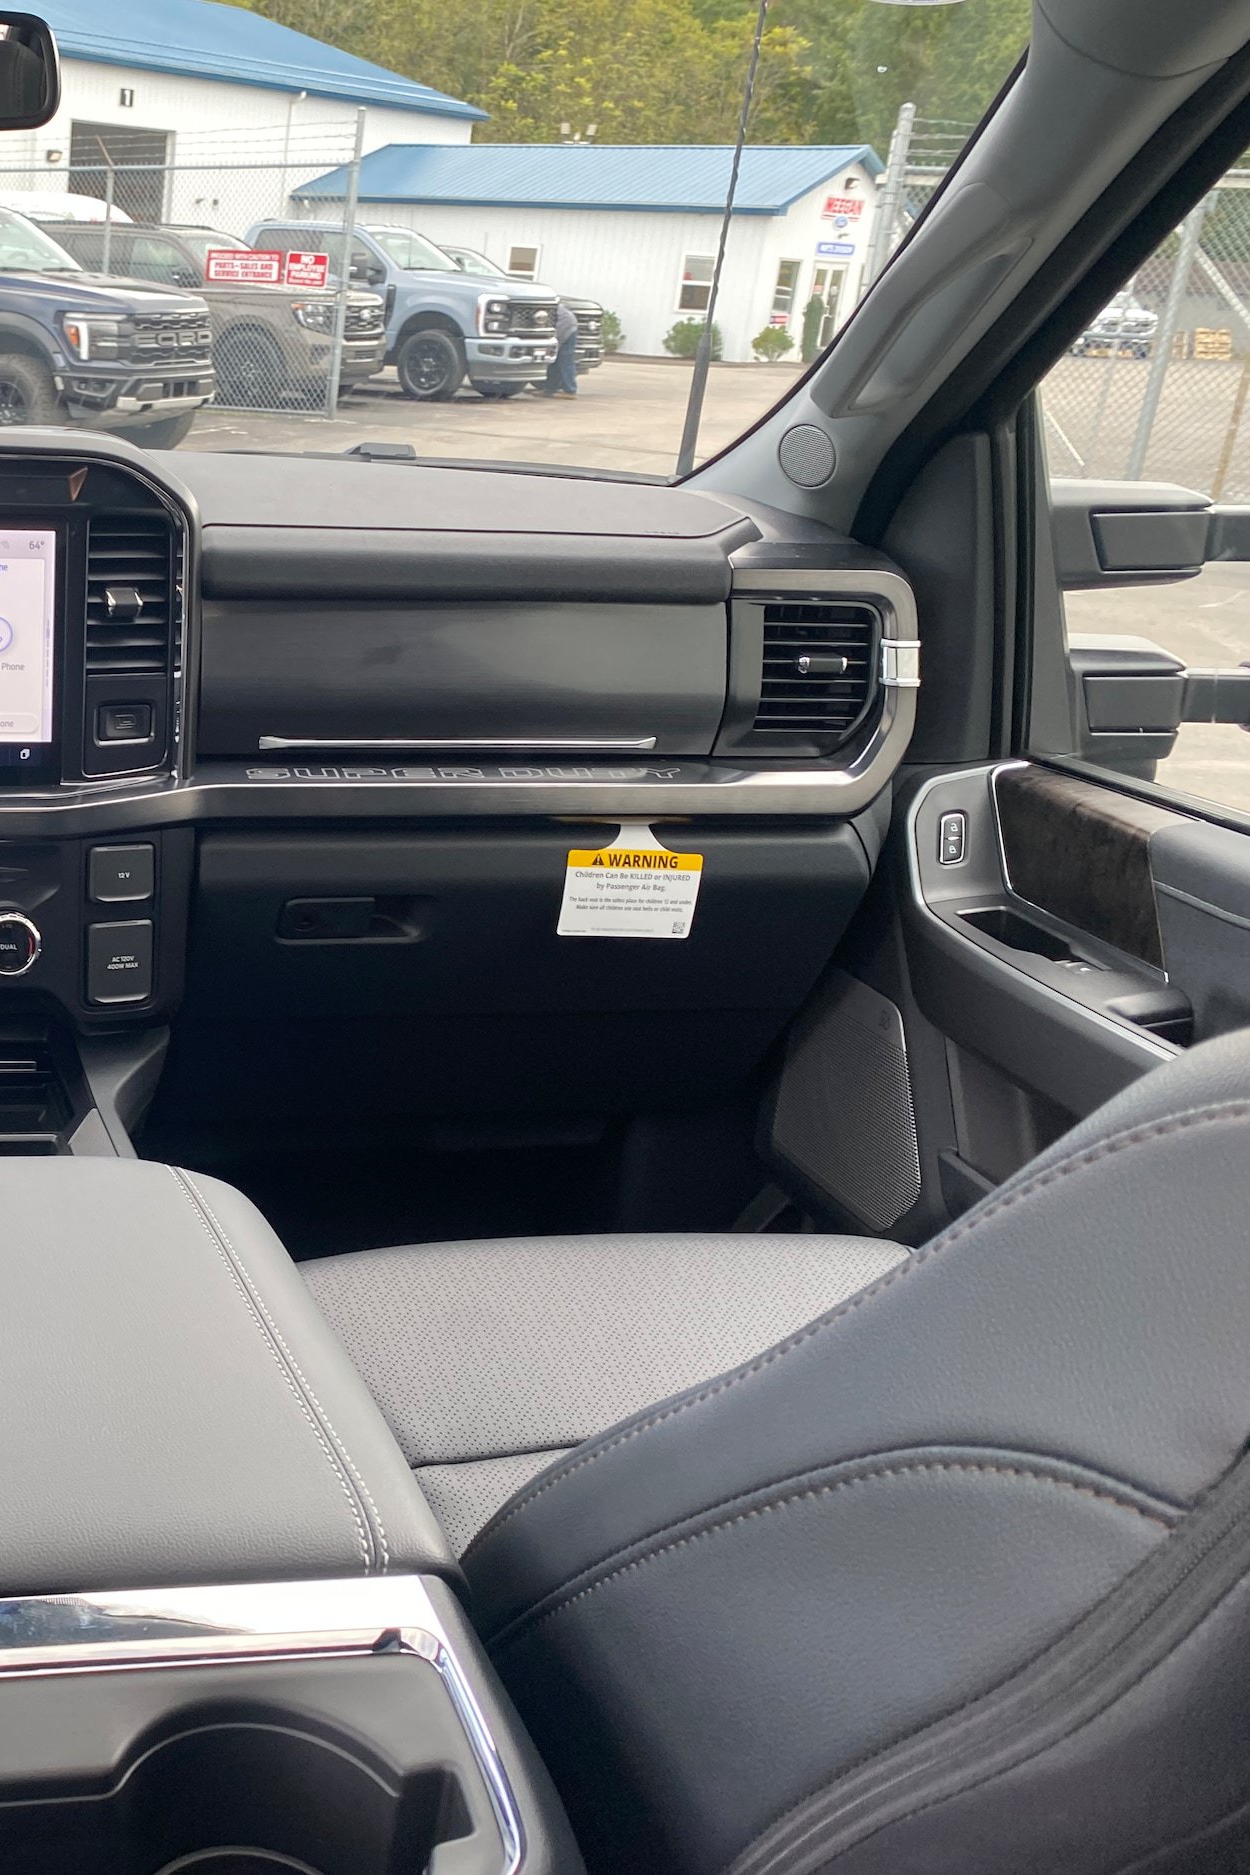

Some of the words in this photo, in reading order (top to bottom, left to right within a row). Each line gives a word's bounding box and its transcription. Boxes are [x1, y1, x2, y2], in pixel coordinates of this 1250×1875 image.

[124, 89, 131, 107] 1
[300, 255, 315, 265] NO
[288, 263, 325, 272] EMPLOYEE
[214, 270, 239, 278] SERVICE
[241, 270, 272, 279] ENTRANCE
[291, 271, 322, 280] PARKING
[134, 330, 211, 348] FORD
[29, 540, 45, 550] 64°
[1, 662, 25, 672] Phone
[246, 766, 484, 780] SUPER
[497, 766, 681, 780] DUTY
[608, 853, 679, 869] WARNING
[575, 871, 604, 879] Children
[662, 874, 691, 882] INJURED
[596, 882, 604, 890] by
[606, 882, 640, 892] Passenger
[641, 883, 651, 891] Air
[652, 884, 667, 892] Bag.
[0, 943, 18, 951] DUAL
[120, 955, 135, 963] 120V
